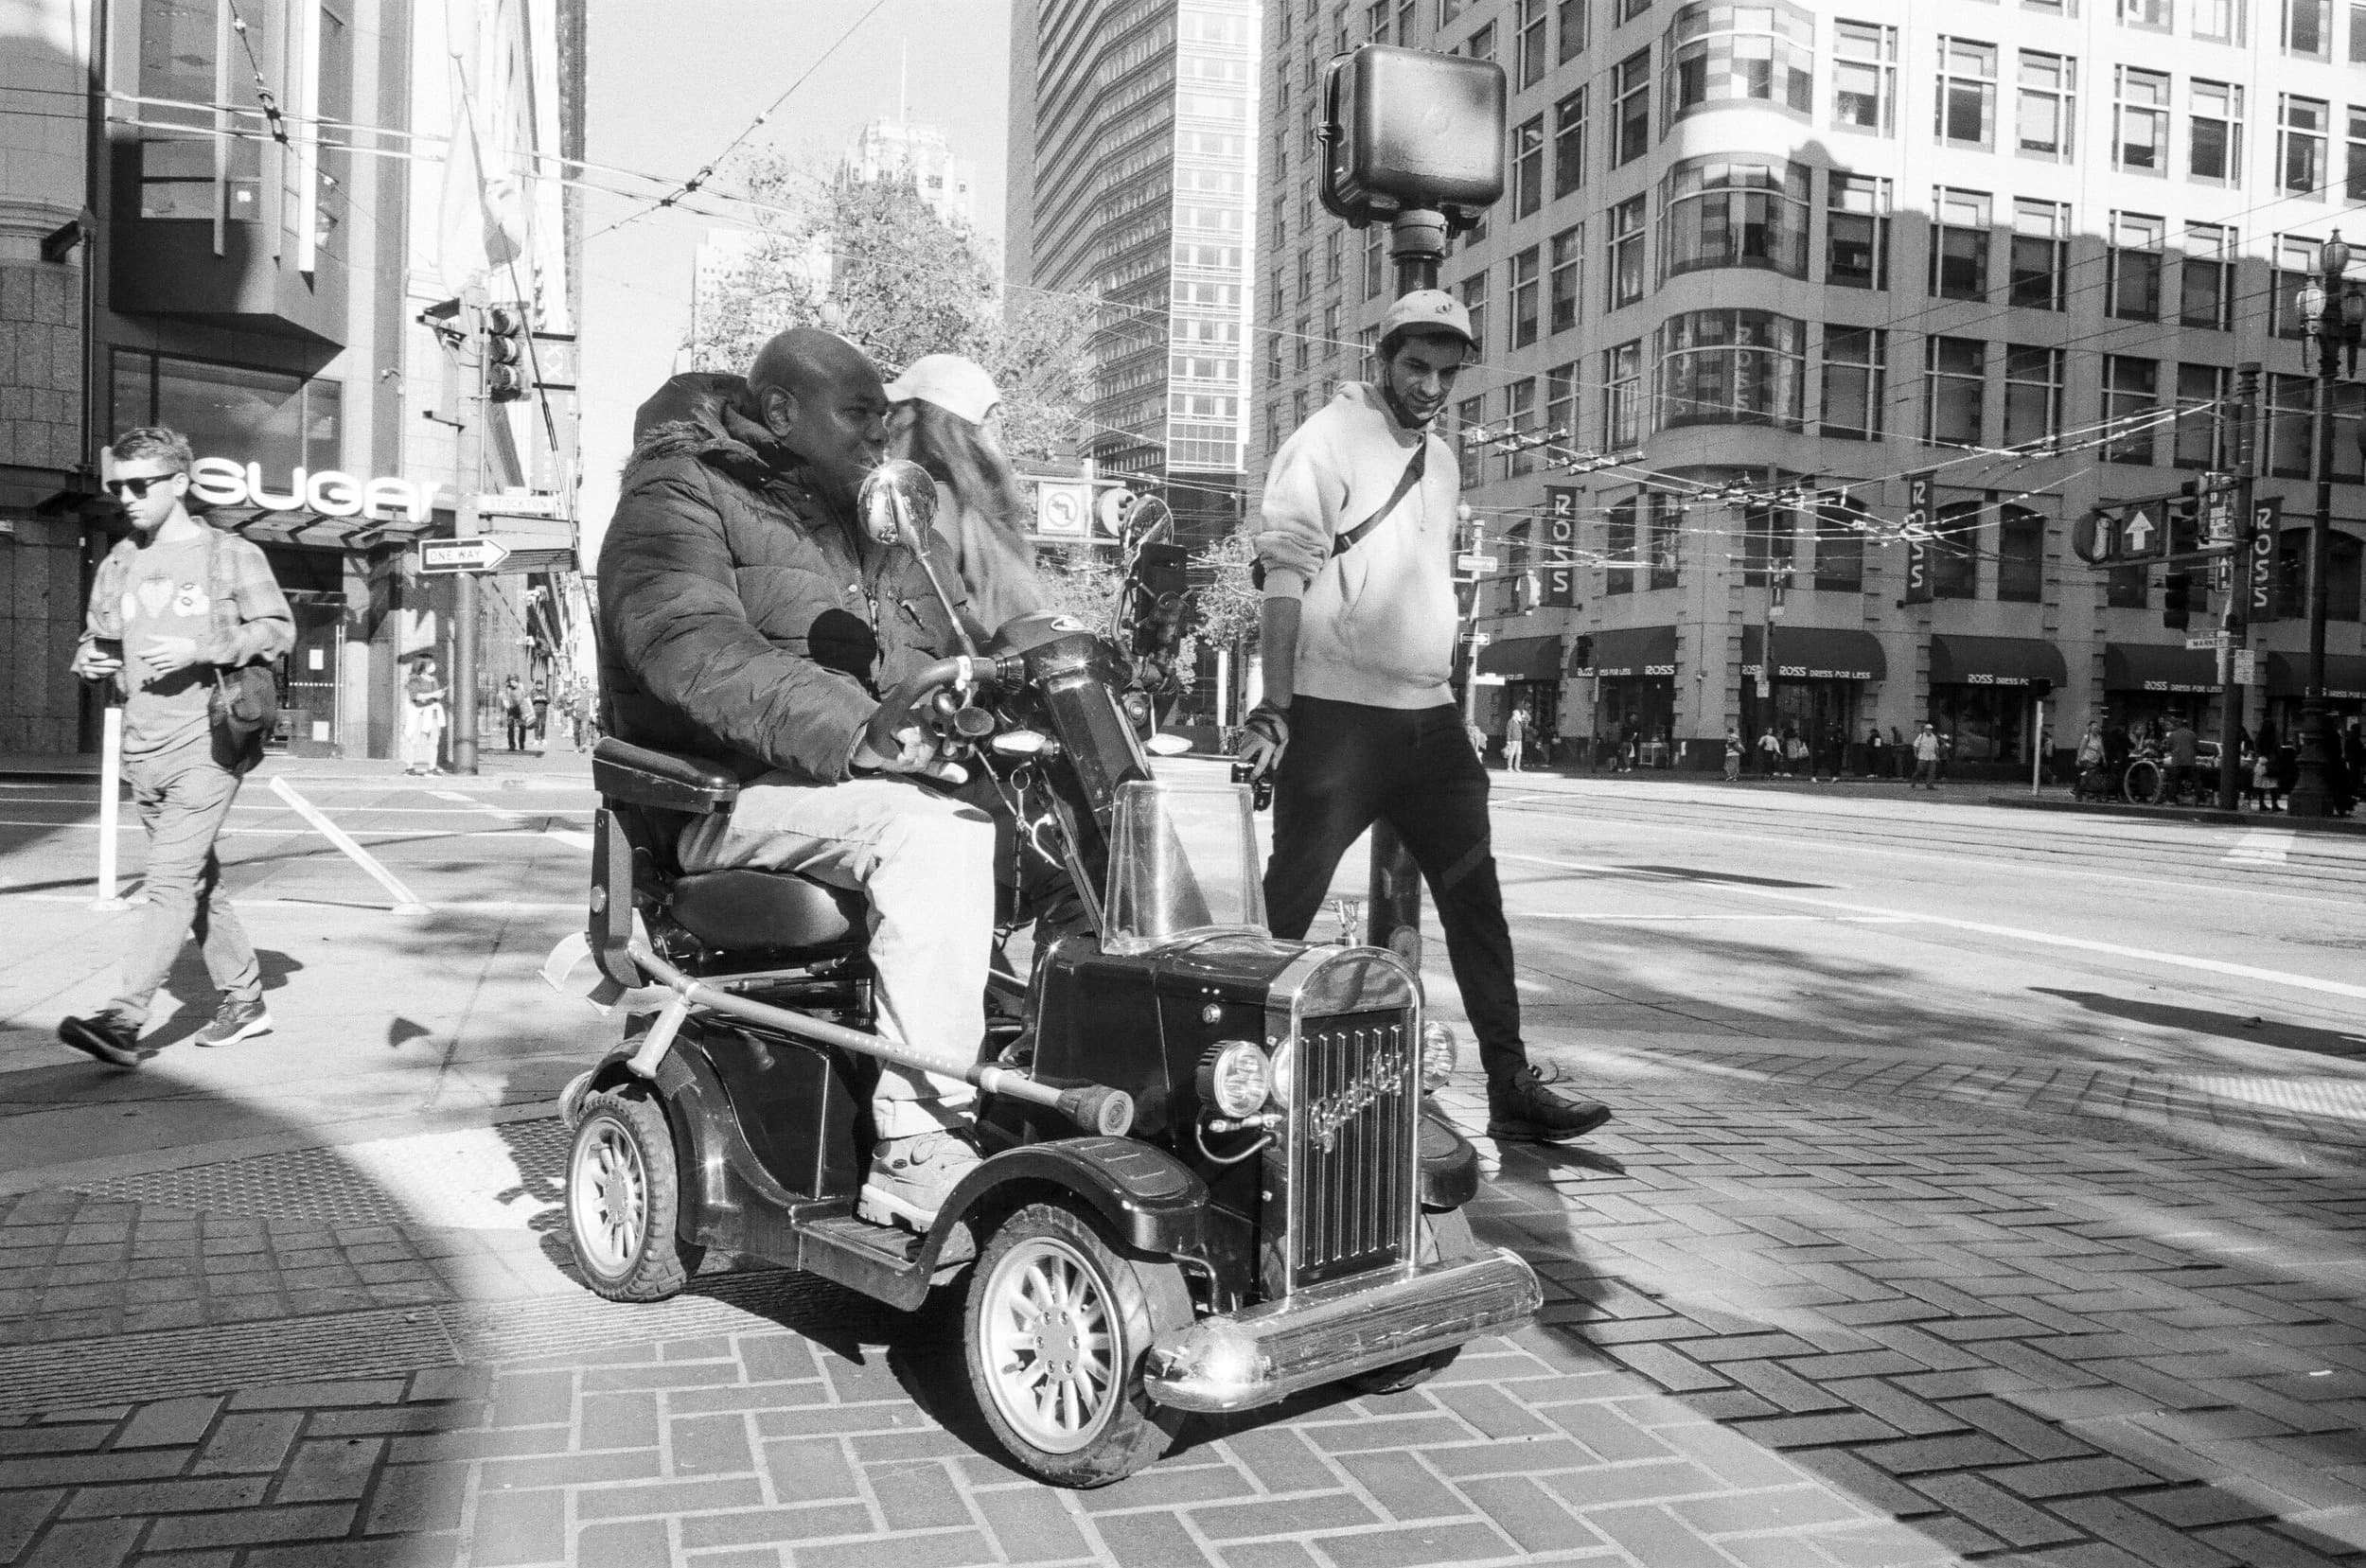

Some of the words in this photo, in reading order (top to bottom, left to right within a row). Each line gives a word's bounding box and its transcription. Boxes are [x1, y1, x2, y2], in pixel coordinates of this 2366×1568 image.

[1910, 481, 1926, 588] ROSS
[1552, 494, 1571, 592] ROSS
[430, 551, 453, 562] ONE
[457, 549, 481, 560] WAY
[2253, 507, 2271, 608] ROSS
[1645, 664, 1675, 676] ROSS
[1778, 665, 1807, 677] ROSS
[1835, 670, 1850, 678] FOR
[1968, 674, 1993, 684] ROSS
[2144, 680, 2168, 691] ROSS
[2170, 683, 2191, 692] DRESS
[2192, 684, 2206, 693] FOR
